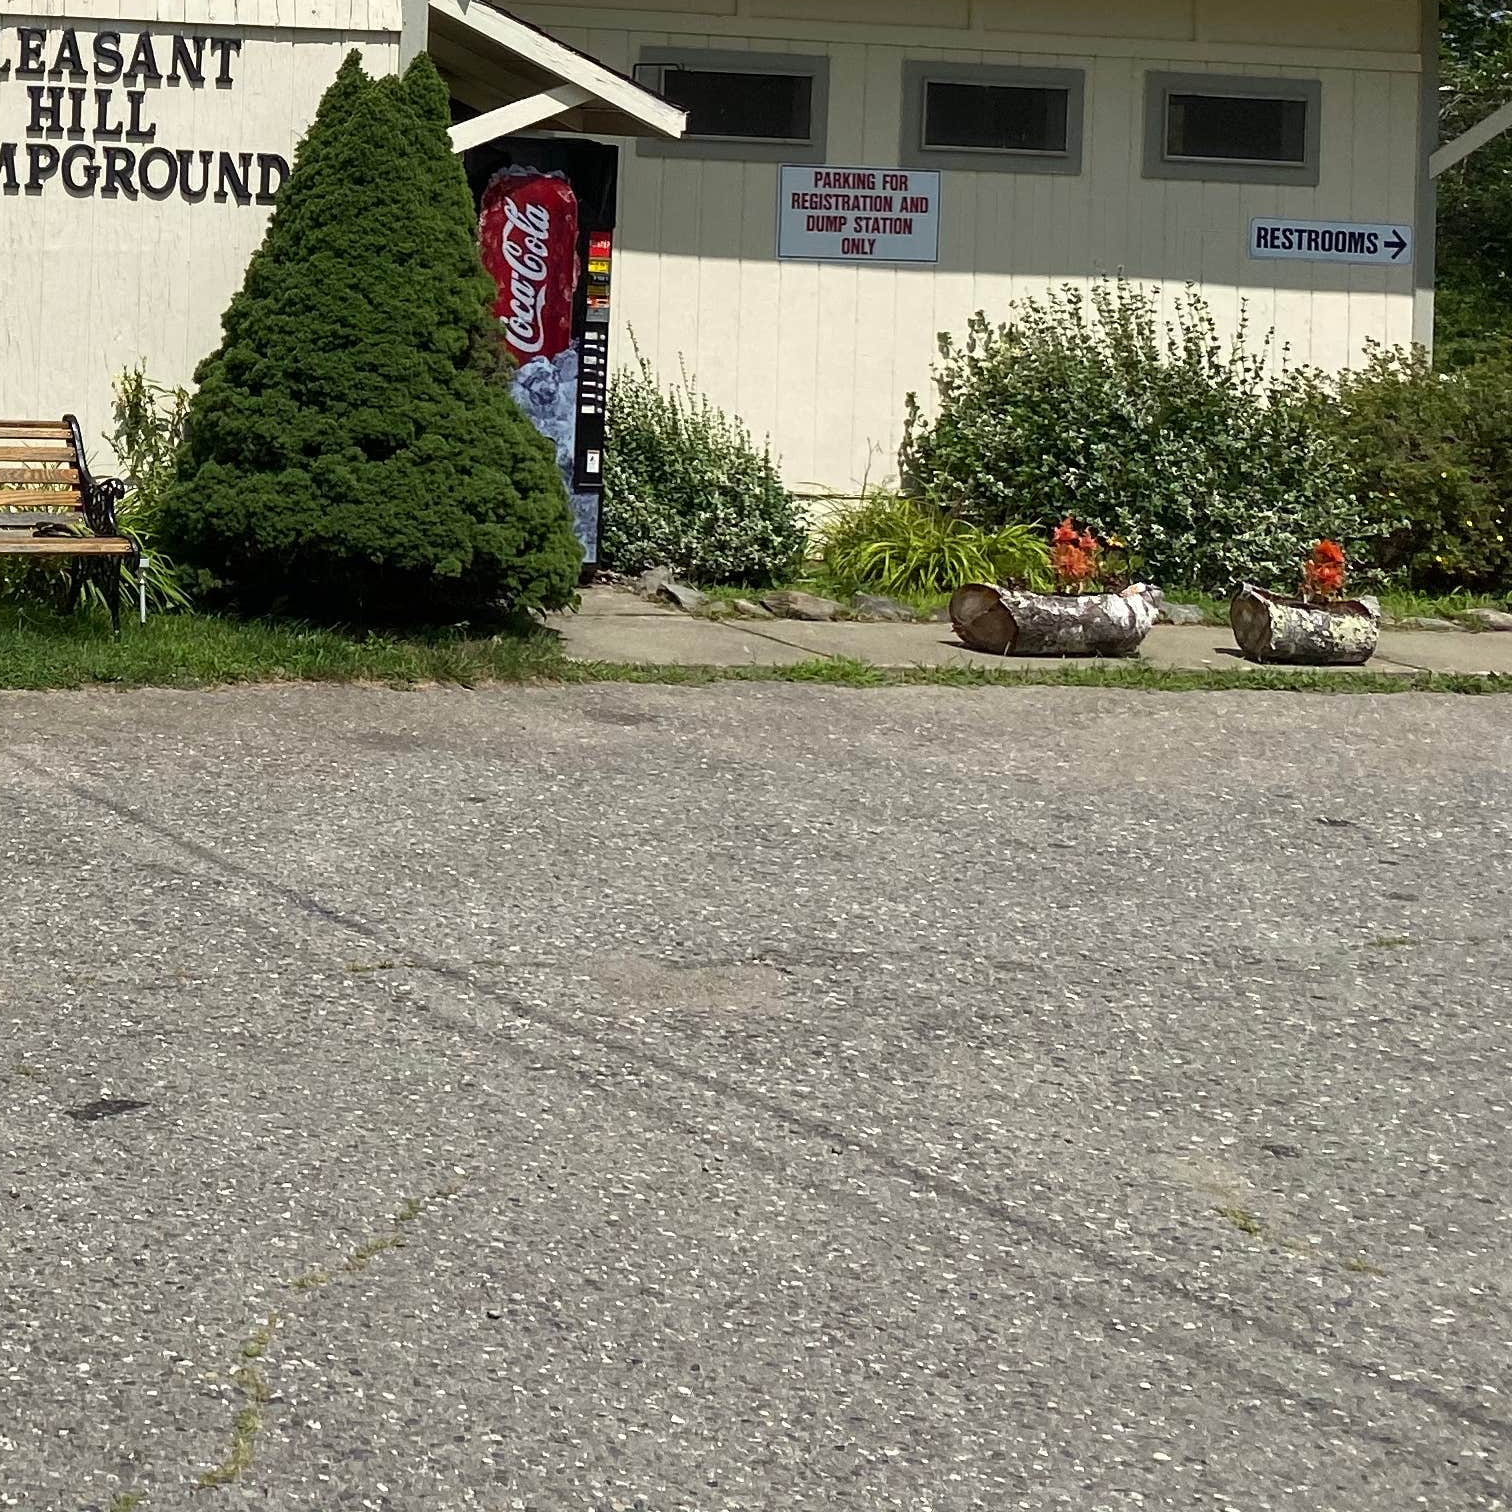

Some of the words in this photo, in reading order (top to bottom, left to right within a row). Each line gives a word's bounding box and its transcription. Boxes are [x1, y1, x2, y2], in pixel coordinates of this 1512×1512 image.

[26, 85, 156, 141] HILL
[814, 171, 876, 190] PARKING
[882, 174, 909, 191] FOR
[791, 192, 893, 213] REGISTRATION
[899, 196, 929, 213] AND
[806, 214, 847, 233] DUMP
[853, 216, 913, 235] STATION
[841, 237, 876, 255] ONLY
[1256, 226, 1379, 255] RESTROOMS
